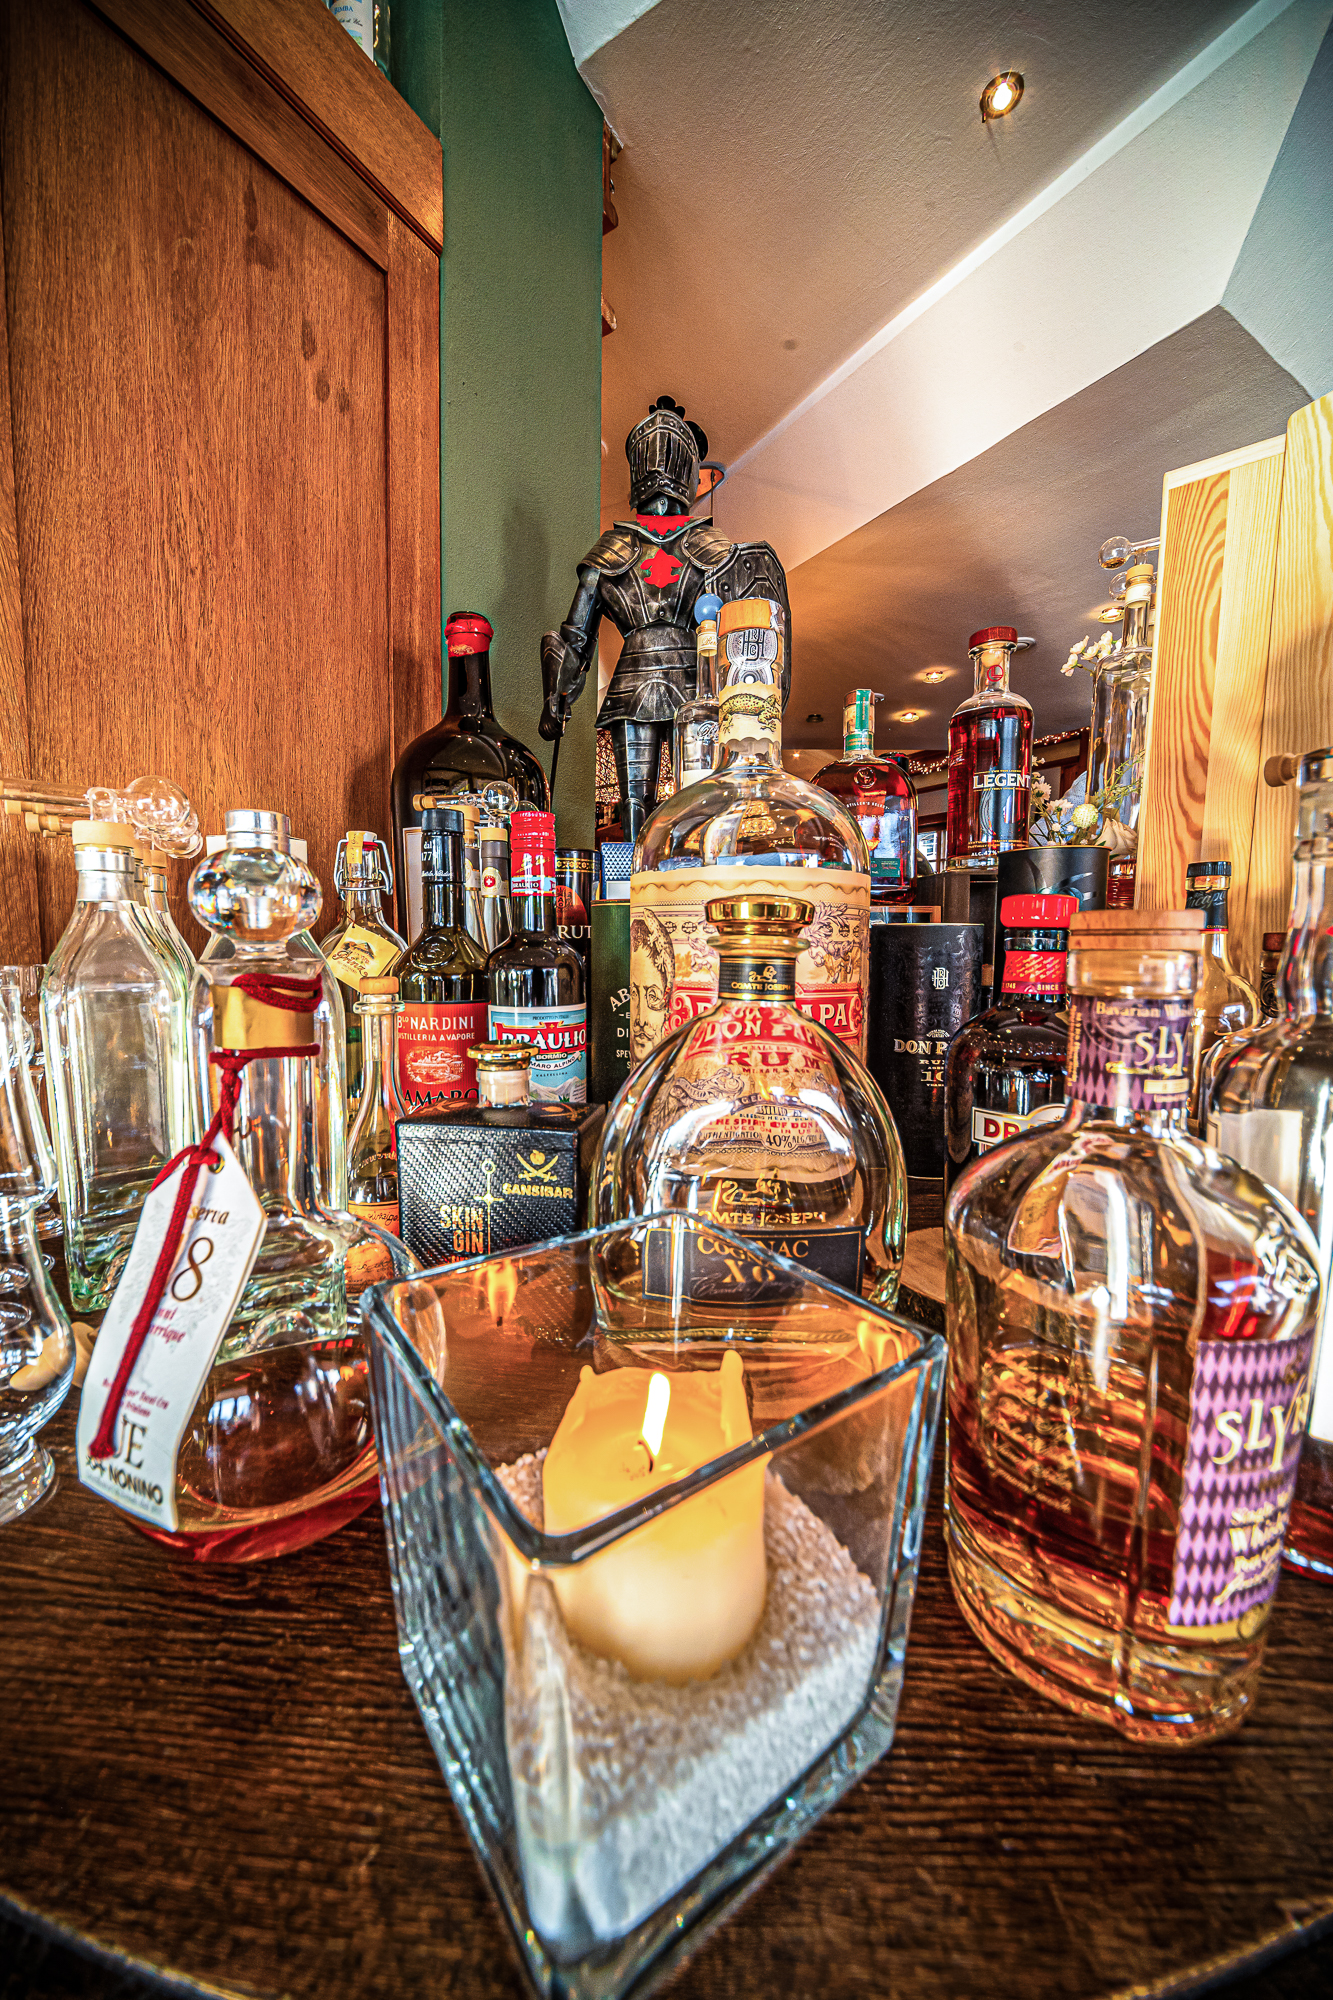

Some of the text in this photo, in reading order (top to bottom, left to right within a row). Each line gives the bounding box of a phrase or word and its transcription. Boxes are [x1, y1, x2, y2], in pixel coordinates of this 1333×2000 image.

[973, 773, 1030, 789] LEGENT
[731, 981, 791, 991] COMTE JOSEPH
[610, 988, 631, 1012] AB
[1096, 1001, 1161, 1018] Bavarian
[410, 1016, 474, 1031] NARDINI
[703, 1021, 762, 1042] DON
[446, 1032, 475, 1041] VAPORE
[893, 1039, 950, 1055] DON P
[1134, 1026, 1184, 1076] SLY
[530, 1056, 576, 1070] MARO ALPINO
[727, 1052, 822, 1070] RUM
[733, 1118, 766, 1127] SPIRIT
[766, 1133, 793, 1149] 40%
[502, 1182, 574, 1200] SANSIBAR
[188, 1205, 230, 1226] serva
[440, 1204, 484, 1232] SKIN
[760, 1211, 826, 1227] JOSEPH
[453, 1228, 484, 1255] GIN
[171, 1236, 214, 1303] 8
[108, 1464, 163, 1506] NONINO
